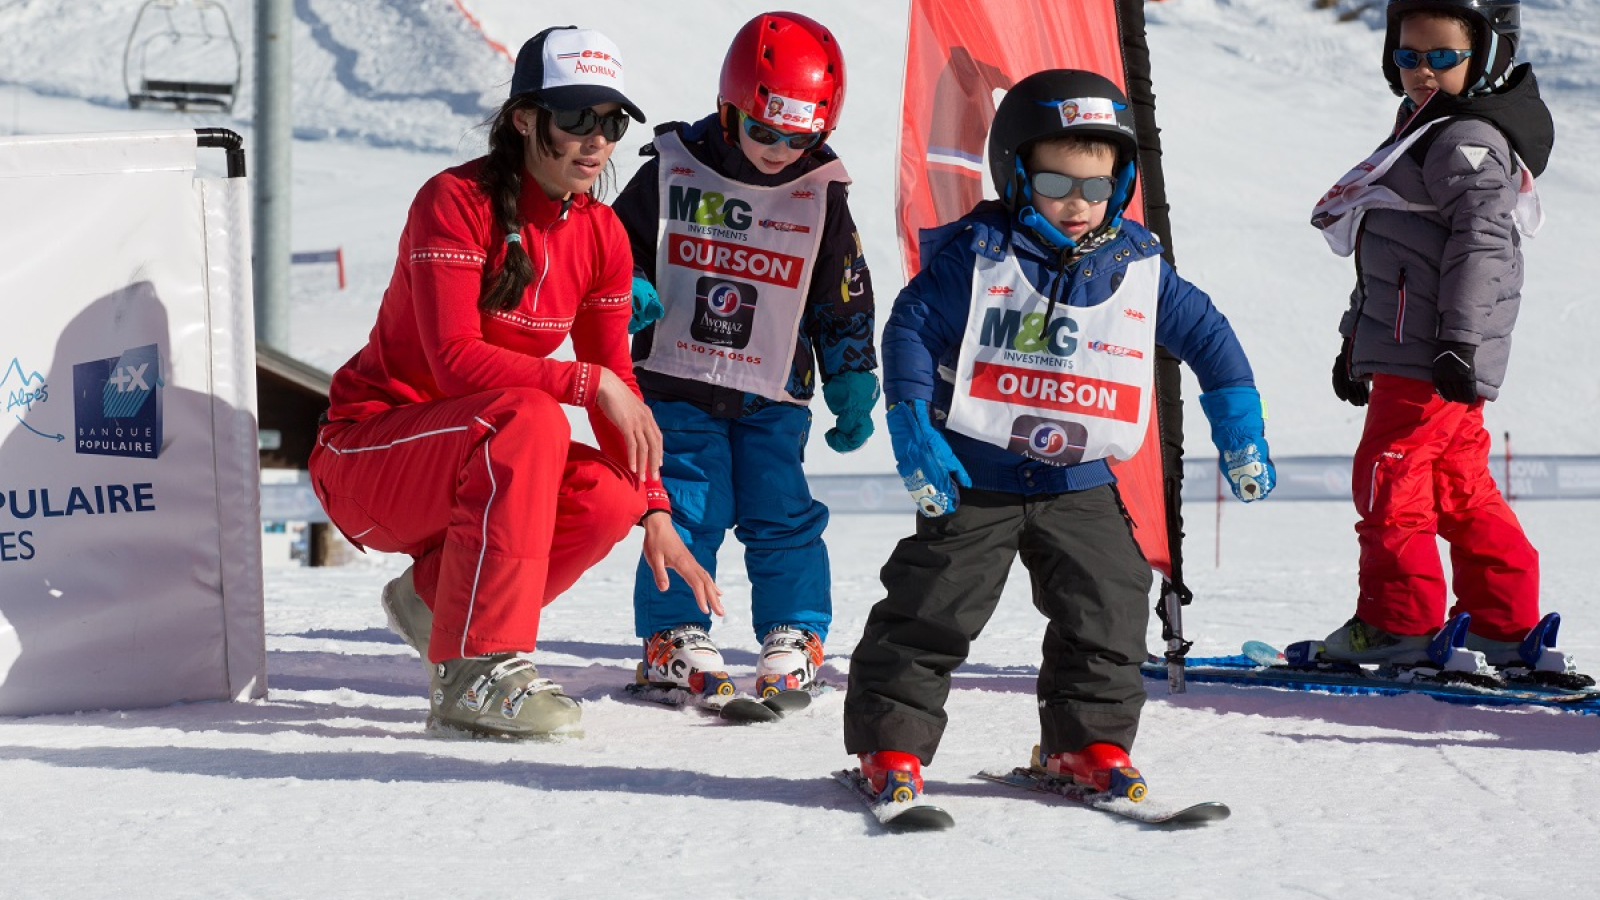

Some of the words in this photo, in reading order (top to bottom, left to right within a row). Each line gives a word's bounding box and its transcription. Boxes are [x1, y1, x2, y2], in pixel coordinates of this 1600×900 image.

[669, 185, 752, 231] M&G
[687, 224, 748, 241] INVESTMENTS
[679, 240, 793, 282] OURSON
[700, 311, 743, 333] AVORIAZ
[979, 307, 1080, 358] M&G
[676, 341, 688, 350] 04
[691, 344, 705, 353] 50
[708, 348, 725, 358] 74
[1003, 351, 1074, 370] INVESTMENTS
[7, 384, 49, 412] Alpes
[996, 373, 1118, 411] OURSON
[79, 427, 152, 437] BANQUE
[79, 440, 153, 452] POPULAIRE
